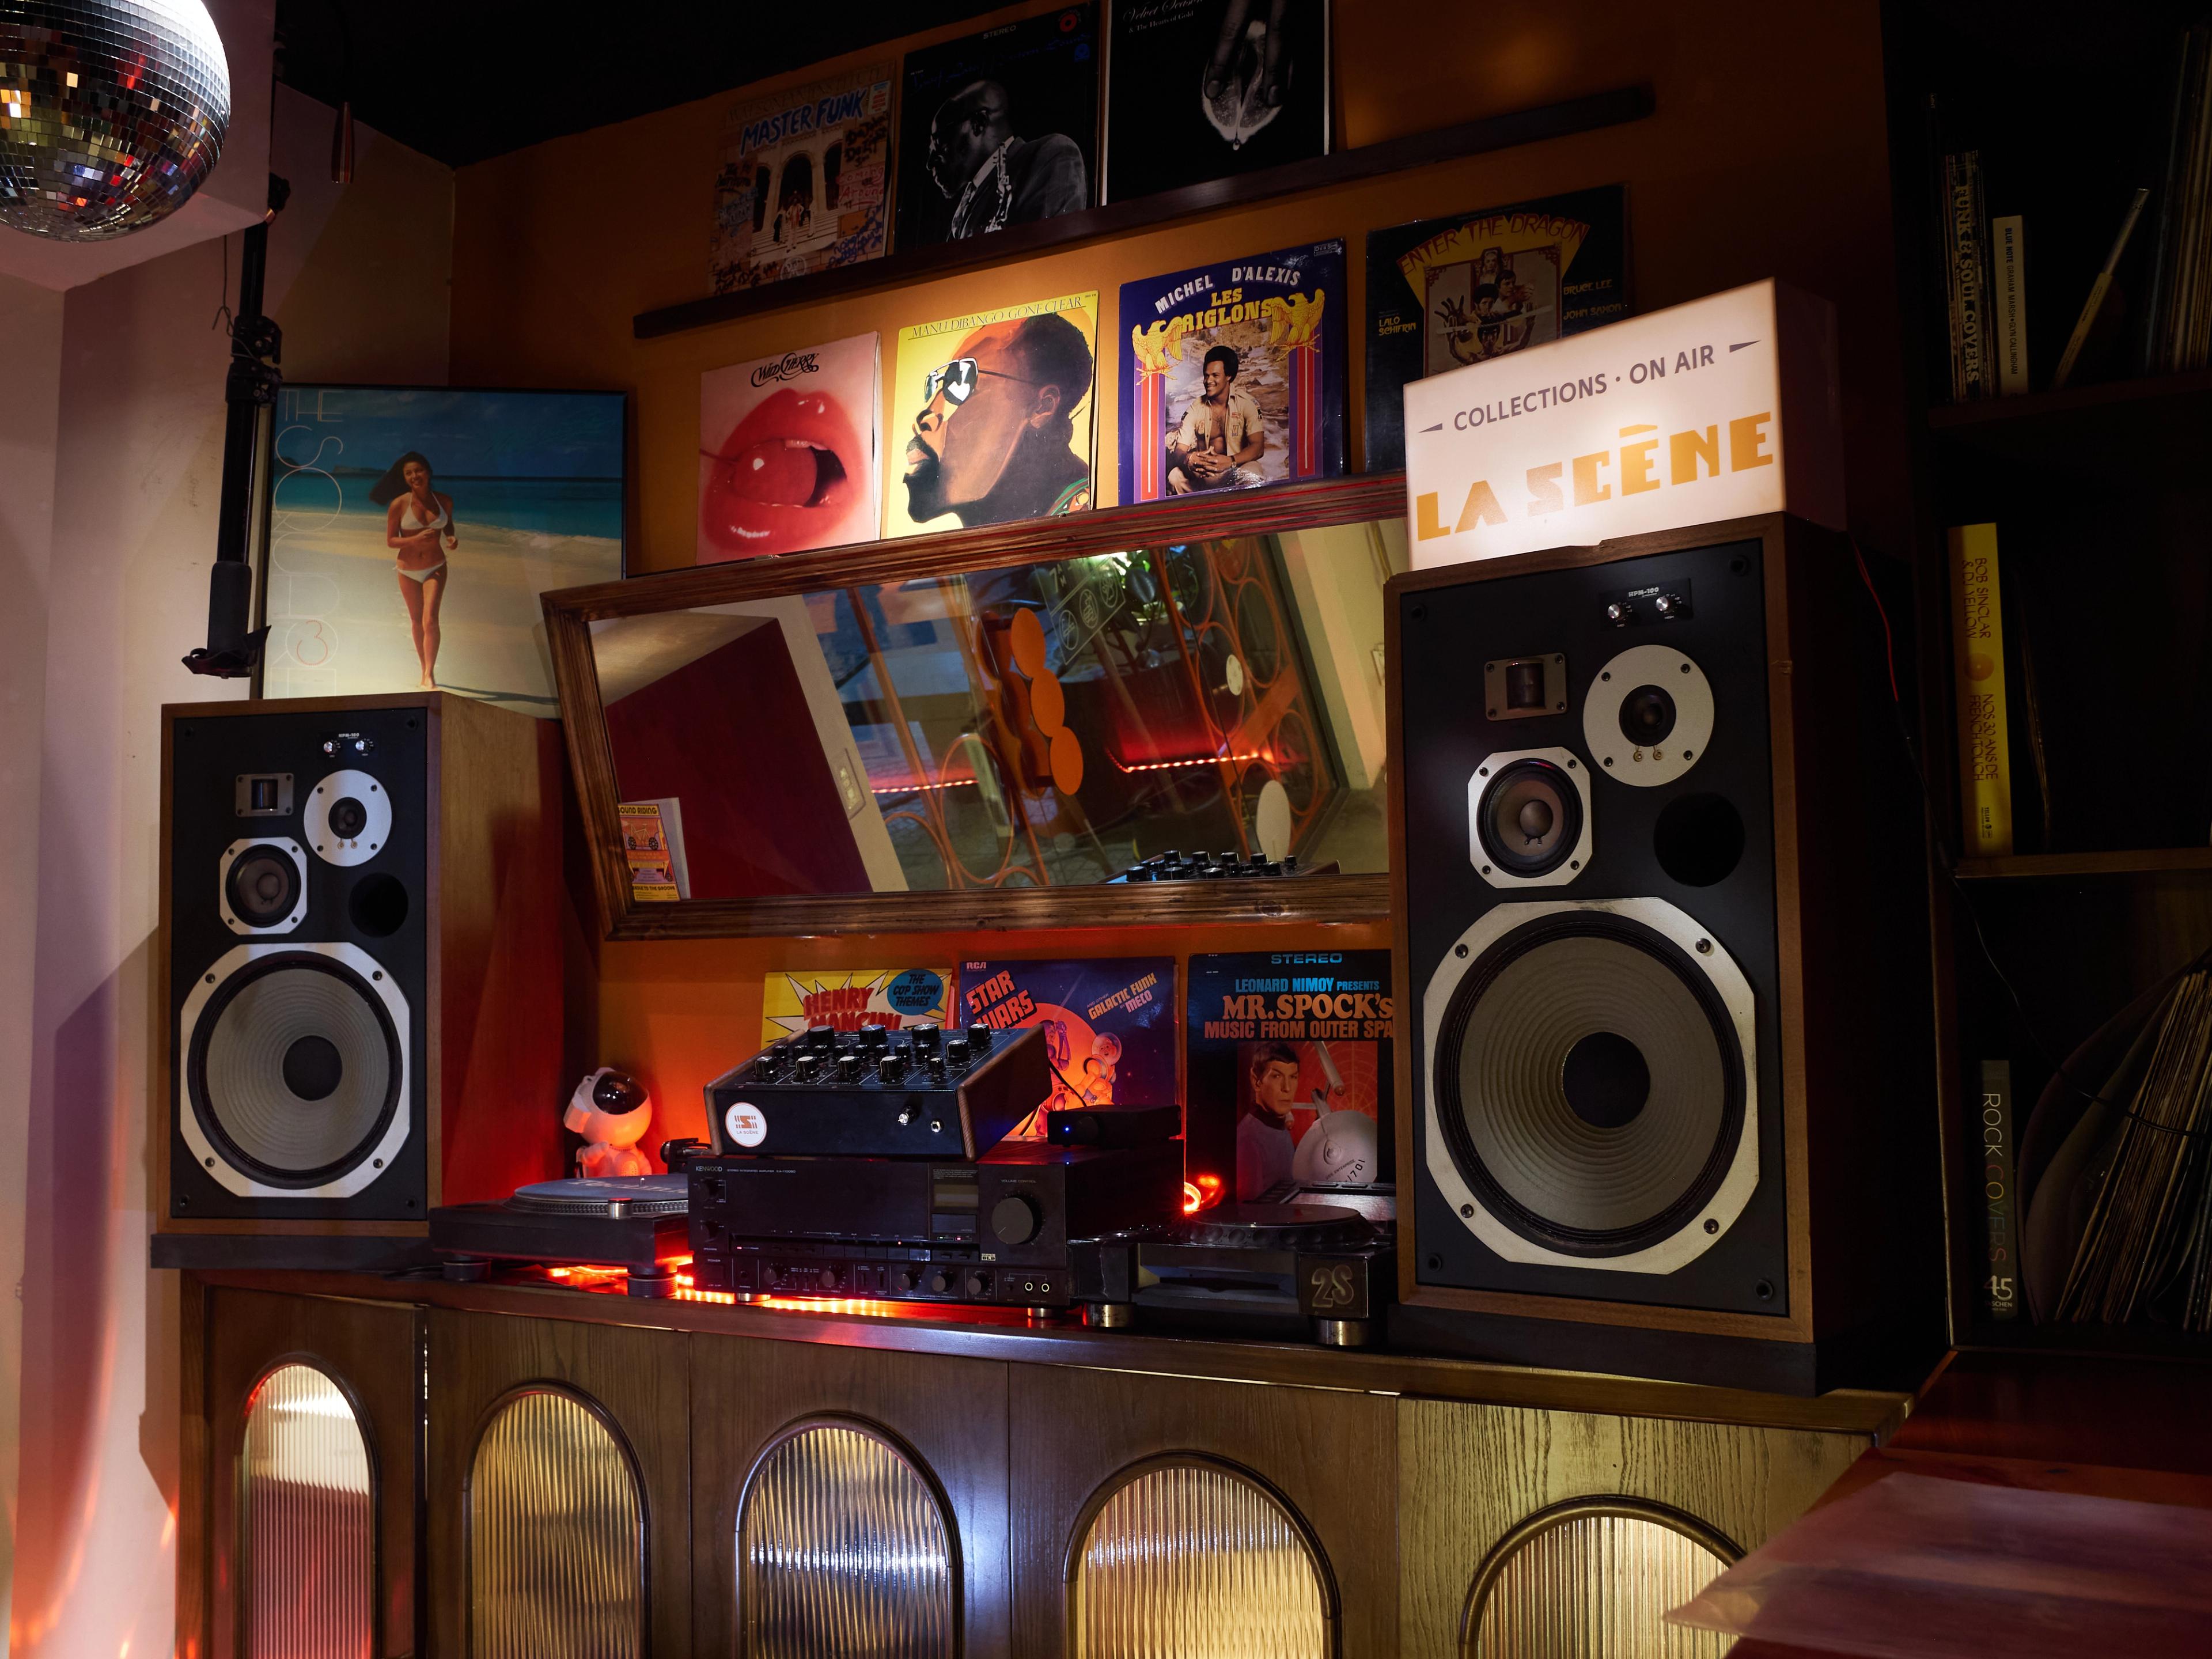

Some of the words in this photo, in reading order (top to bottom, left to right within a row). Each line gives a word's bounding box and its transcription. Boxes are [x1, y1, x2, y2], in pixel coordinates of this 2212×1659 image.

[1123, 1, 1158, 22] Velvet
[1136, 23, 1148, 32] The
[1150, 18, 1170, 28] Hearts
[1178, 10, 1194, 20] Gold
[982, 25, 1017, 40] STEREO
[739, 104, 812, 158] MASTER
[816, 88, 868, 130] FUNK
[1954, 184, 1973, 235] FUNK
[1396, 228, 1461, 275] ENTER
[1464, 214, 1505, 243] THE
[1509, 213, 1591, 242] DRAGON
[1959, 240, 1973, 253] &
[1154, 274, 1214, 314] MICHEL
[1232, 266, 1301, 286] D'ALEXIS
[1563, 281, 1594, 296] BRUCE
[1595, 278, 1614, 289] LEE
[1960, 258, 1975, 305] SOUL
[1211, 287, 1242, 306] LES
[912, 321, 948, 338] MANU
[950, 311, 1004, 332] DIBANGO
[1008, 304, 1042, 318] GONE
[1045, 296, 1082, 312] CLEAR
[1181, 298, 1274, 334] AIGLONS
[1378, 315, 1401, 327] LALO
[1563, 308, 1588, 321] JOHN
[1589, 302, 1623, 316] SAXON
[1378, 323, 1417, 337] SCHIFRIN
[1963, 309, 1979, 381] COVERS
[2010, 338, 2018, 375] CALLINGHAM
[1453, 373, 1608, 431] COLLECTIONS
[1629, 356, 1666, 385] ON
[1674, 344, 1715, 374] AIR
[1415, 479, 1509, 542] LA
[1961, 559, 1974, 569] &
[1974, 557, 1987, 582] BOB
[1962, 571, 1975, 586] DJ
[1628, 586, 1660, 597] HPM-100
[1963, 589, 1977, 639] YELLOW
[1976, 585, 1991, 639] SINCLAR
[1968, 695, 1982, 739] FRENCH
[1982, 694, 1994, 719] NOS
[1984, 721, 1996, 736] 30
[1971, 741, 1984, 781] TOUCH
[1985, 738, 1997, 762] ANS
[1986, 764, 1998, 779] DE
[618, 806, 636, 814] OUND
[967, 961, 987, 969] RCA
[1271, 953, 1343, 964] STEREO
[893, 984, 911, 995] COP
[912, 984, 940, 995] SHOW
[908, 974, 924, 984] THE
[1235, 978, 1289, 993] LEONARD
[1292, 977, 1335, 993] NIMOY
[1336, 980, 1380, 991] PRESENTS
[804, 987, 875, 1021] HENRY
[896, 995, 931, 1007] THEMES
[965, 969, 1016, 1015] STAR
[1088, 987, 1131, 1021] GALACTIC
[1130, 972, 1158, 995] FUNK
[1124, 989, 1153, 1013] MECO
[975, 989, 1037, 1029] WARS
[1222, 994, 1275, 1020] MR.
[807, 1011, 903, 1031] MANCINI
[1205, 1021, 1255, 1039] MUSIC
[1260, 1020, 1304, 1039] FROM
[1309, 1020, 1359, 1038] OUTER
[1982, 1093, 2003, 1158] ROCK
[1984, 1164, 2008, 1262] COVERS
